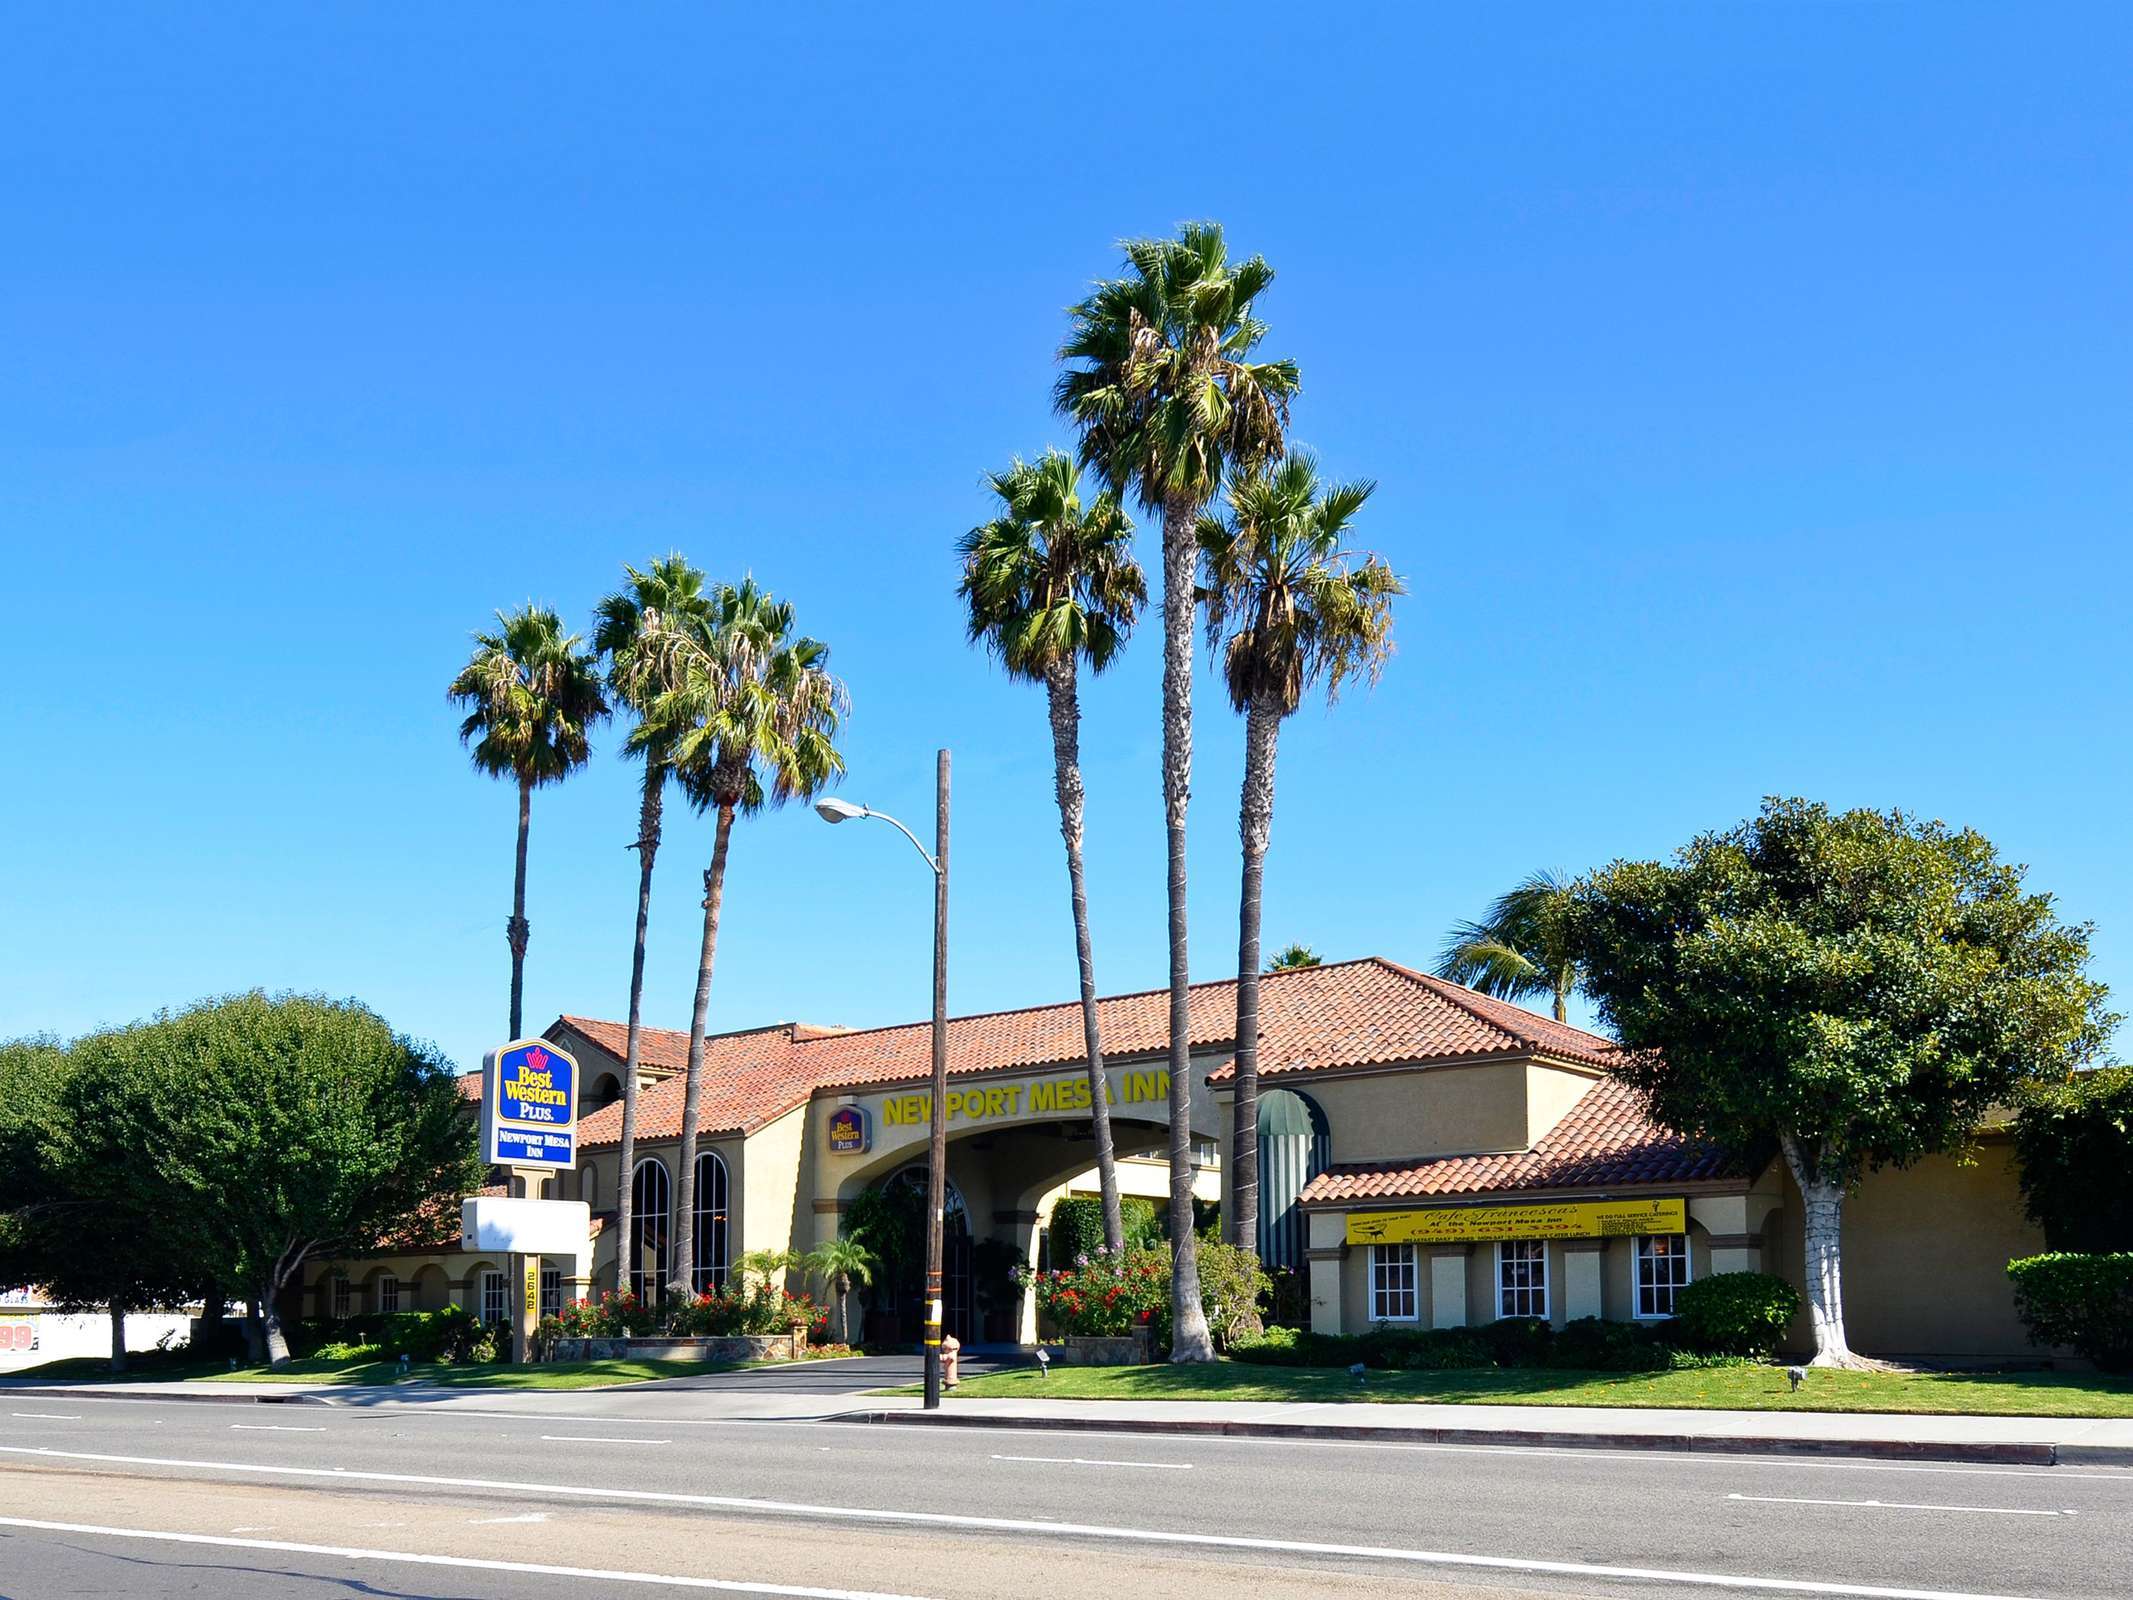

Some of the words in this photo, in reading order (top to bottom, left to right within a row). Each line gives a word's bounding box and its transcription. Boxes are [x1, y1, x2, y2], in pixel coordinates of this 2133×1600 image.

[518, 1066, 552, 1088] Best
[504, 1080, 567, 1106] Western
[1030, 1078, 1113, 1113] MES
[831, 1131, 860, 1141] Western
[836, 1122, 852, 1132] Best
[499, 1130, 543, 1146] NEWPORT
[544, 1134, 570, 1148] MESA
[526, 1145, 543, 1158] INN
[1469, 1219, 1512, 1227] Newport
[527, 1271, 535, 1310] 2642
